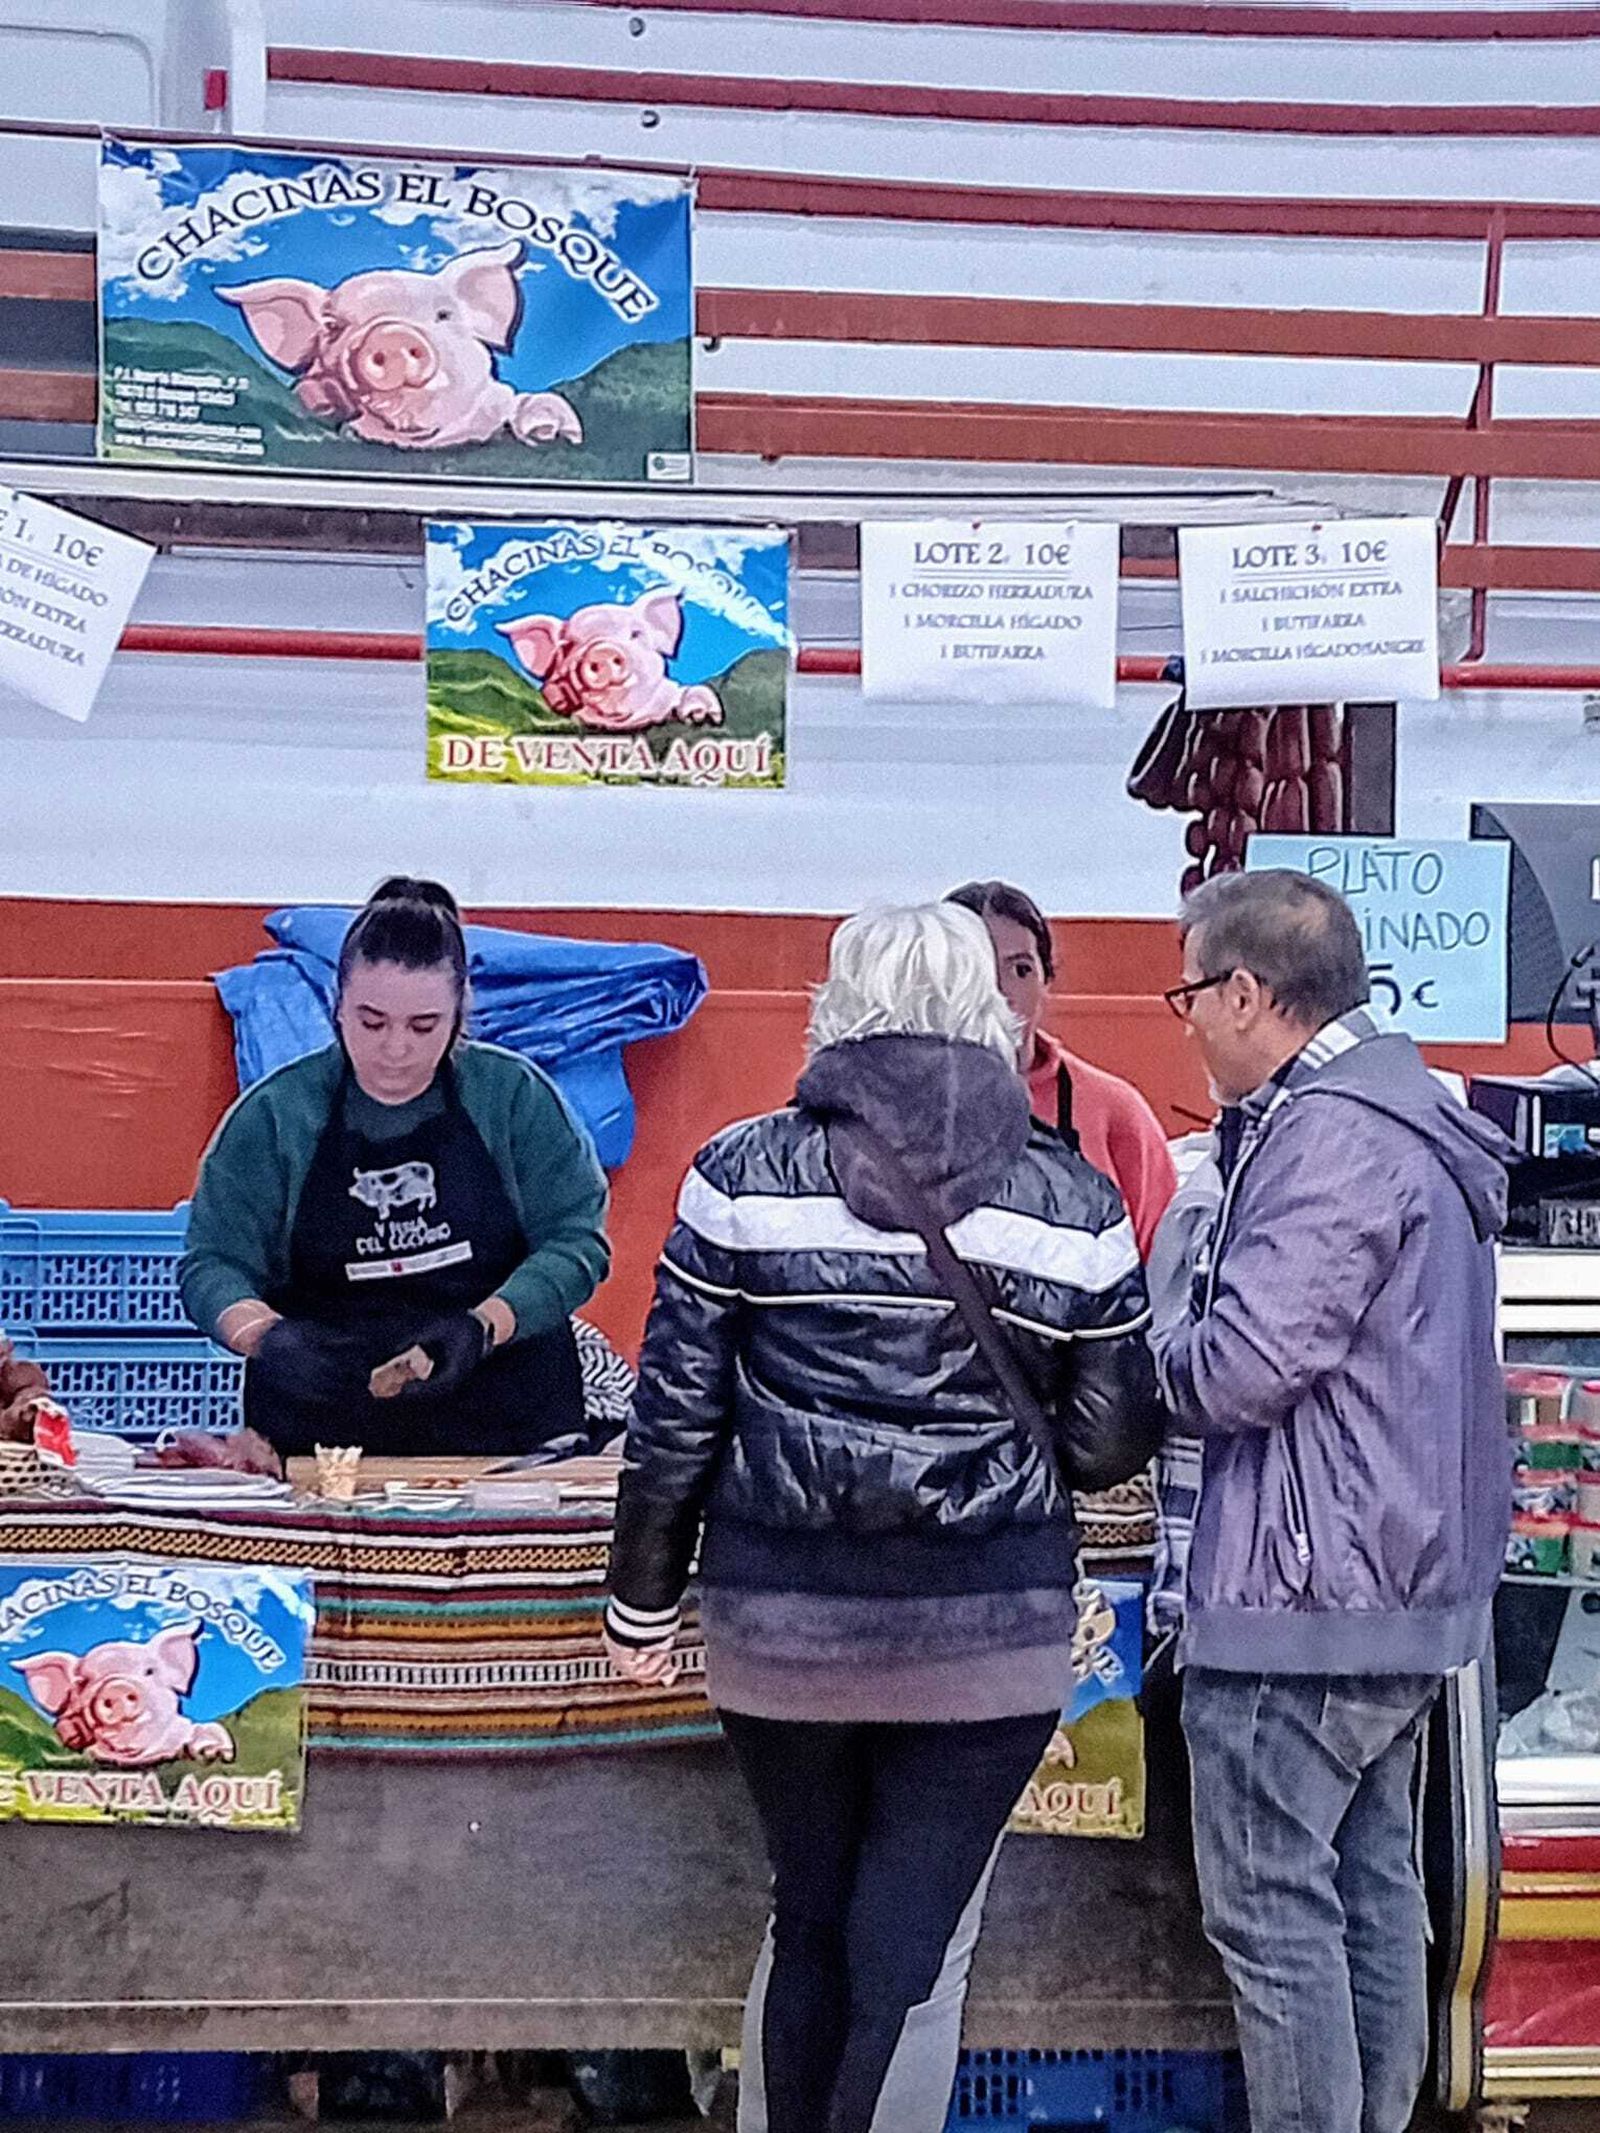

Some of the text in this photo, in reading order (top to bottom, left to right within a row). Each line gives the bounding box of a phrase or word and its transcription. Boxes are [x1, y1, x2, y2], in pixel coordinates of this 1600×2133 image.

[137, 172, 655, 320] CHACINAS EL BOSQUE
[53, 533, 104, 567] 10€
[914, 543, 980, 564] LOTE
[1025, 544, 1071, 565] 10€
[1232, 545, 1297, 568] LOTE
[1341, 540, 1388, 563] 10€
[446, 535, 600, 622] CHACINAS
[608, 536, 643, 558] EL
[902, 584, 983, 600] CHORIZO
[1348, 581, 1403, 598] EXTRA
[916, 613, 1004, 629] MORCILLA
[1211, 646, 1293, 664] MORCILLA
[447, 732, 770, 782] DE VENTA AQUÍ
[128, 1572, 157, 1597] EL
[168, 1581, 284, 1670] BOSQUE
[25, 1774, 164, 1807] VENTA
[176, 1772, 281, 1819] AQUÍ
[1015, 1778, 1121, 1824] AQUÍ
